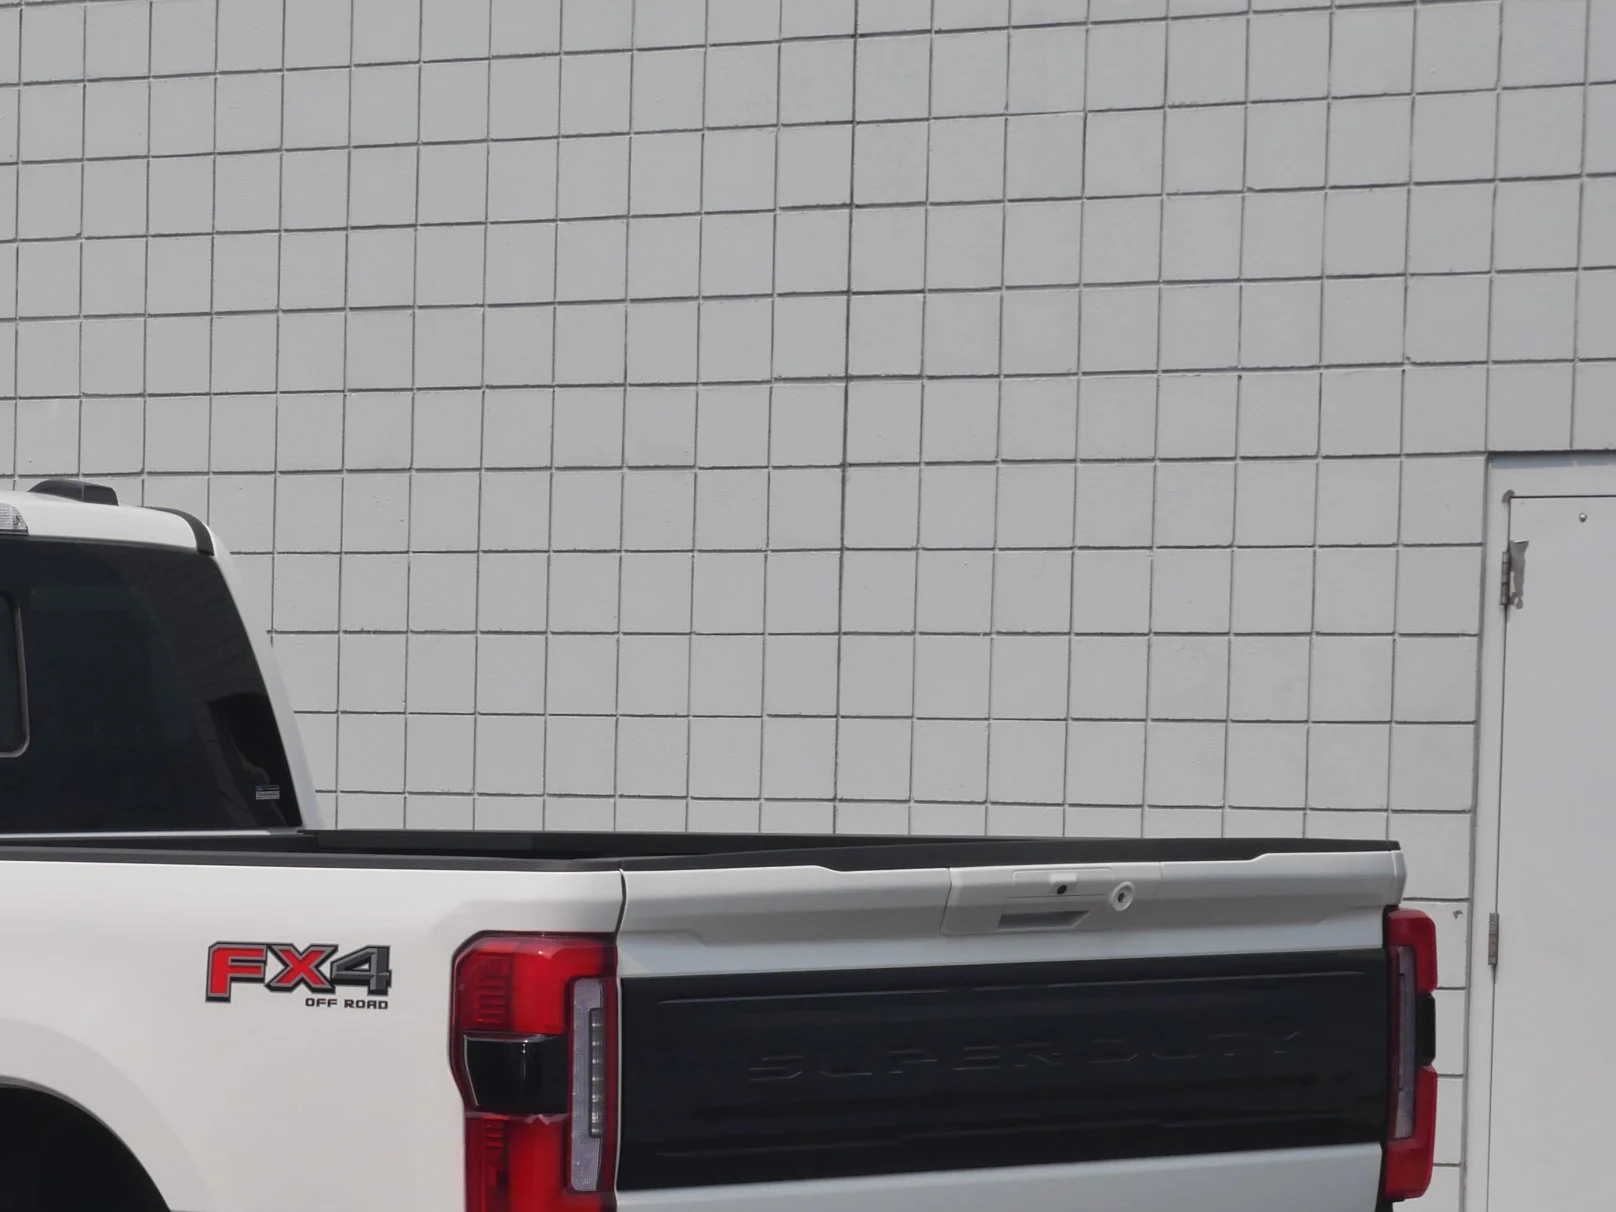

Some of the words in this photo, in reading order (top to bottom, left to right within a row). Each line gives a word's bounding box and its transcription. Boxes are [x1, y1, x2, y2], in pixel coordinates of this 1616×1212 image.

[205, 941, 392, 1003] FX4
[305, 998, 338, 1008] OFF
[344, 999, 389, 1010] ROAD
[747, 1042, 1063, 1082] SUPER
